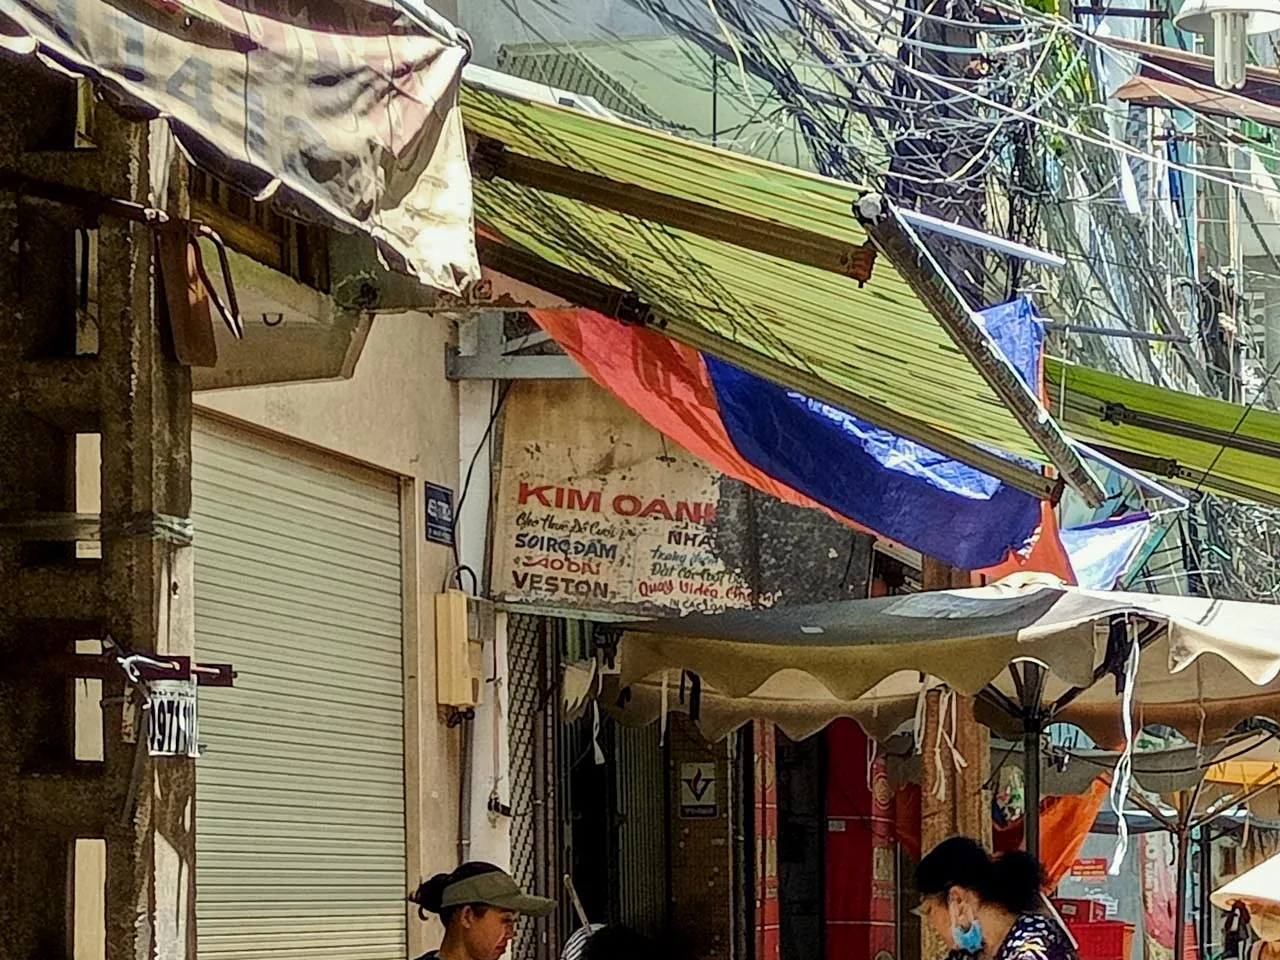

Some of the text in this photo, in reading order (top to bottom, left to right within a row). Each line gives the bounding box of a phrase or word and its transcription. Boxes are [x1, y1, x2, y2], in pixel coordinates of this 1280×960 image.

[518, 481, 602, 513] KIM
[511, 569, 609, 598] VESTON
[638, 580, 674, 598] Quay
